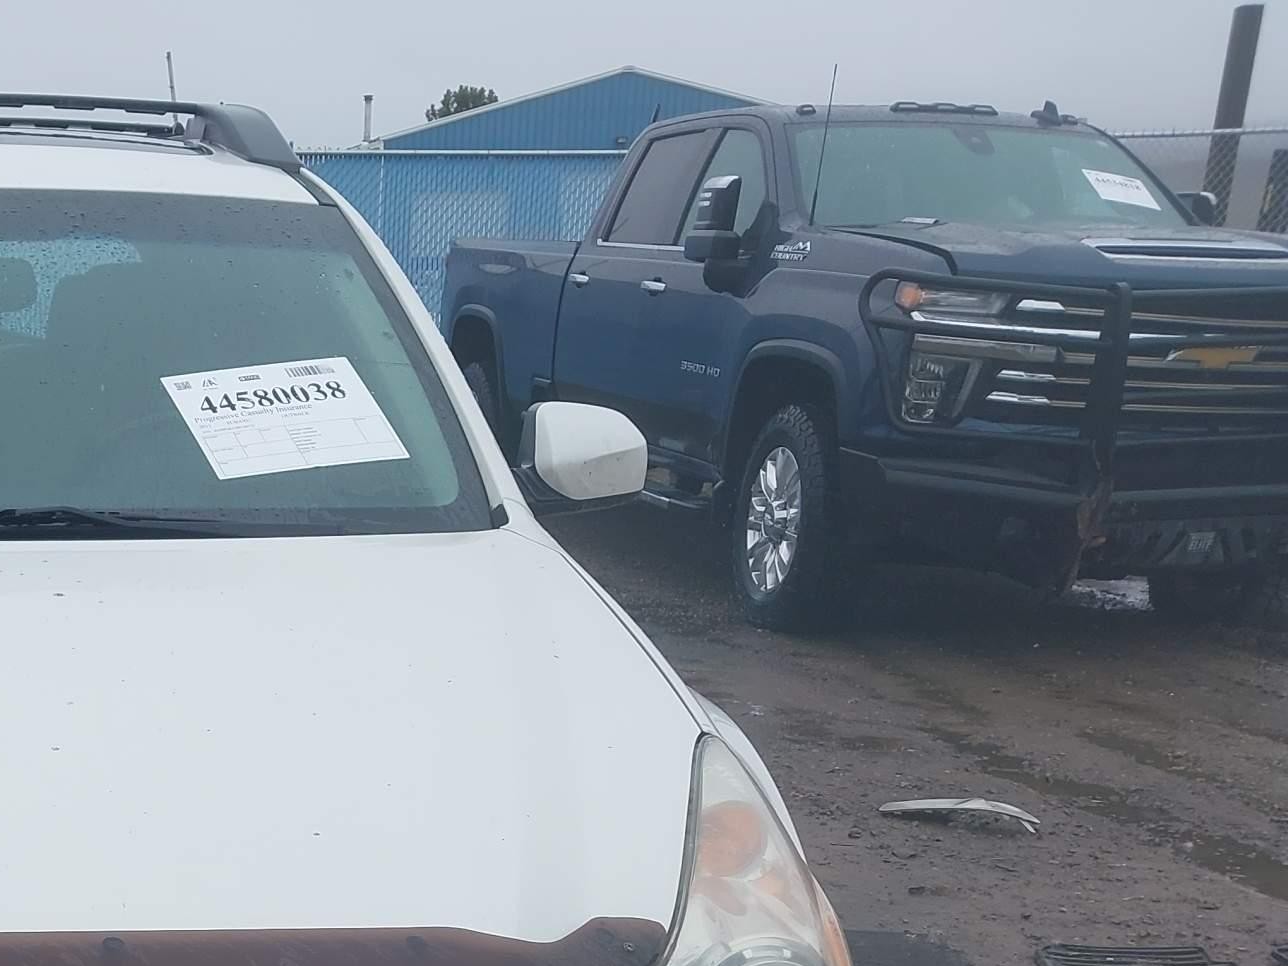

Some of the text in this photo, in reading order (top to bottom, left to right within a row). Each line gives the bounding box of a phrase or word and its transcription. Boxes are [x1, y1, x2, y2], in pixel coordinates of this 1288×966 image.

[680, 360, 721, 377] 3500 HD
[200, 380, 347, 414] 44580038
[194, 404, 313, 424] Progressive Casualty Insurance
